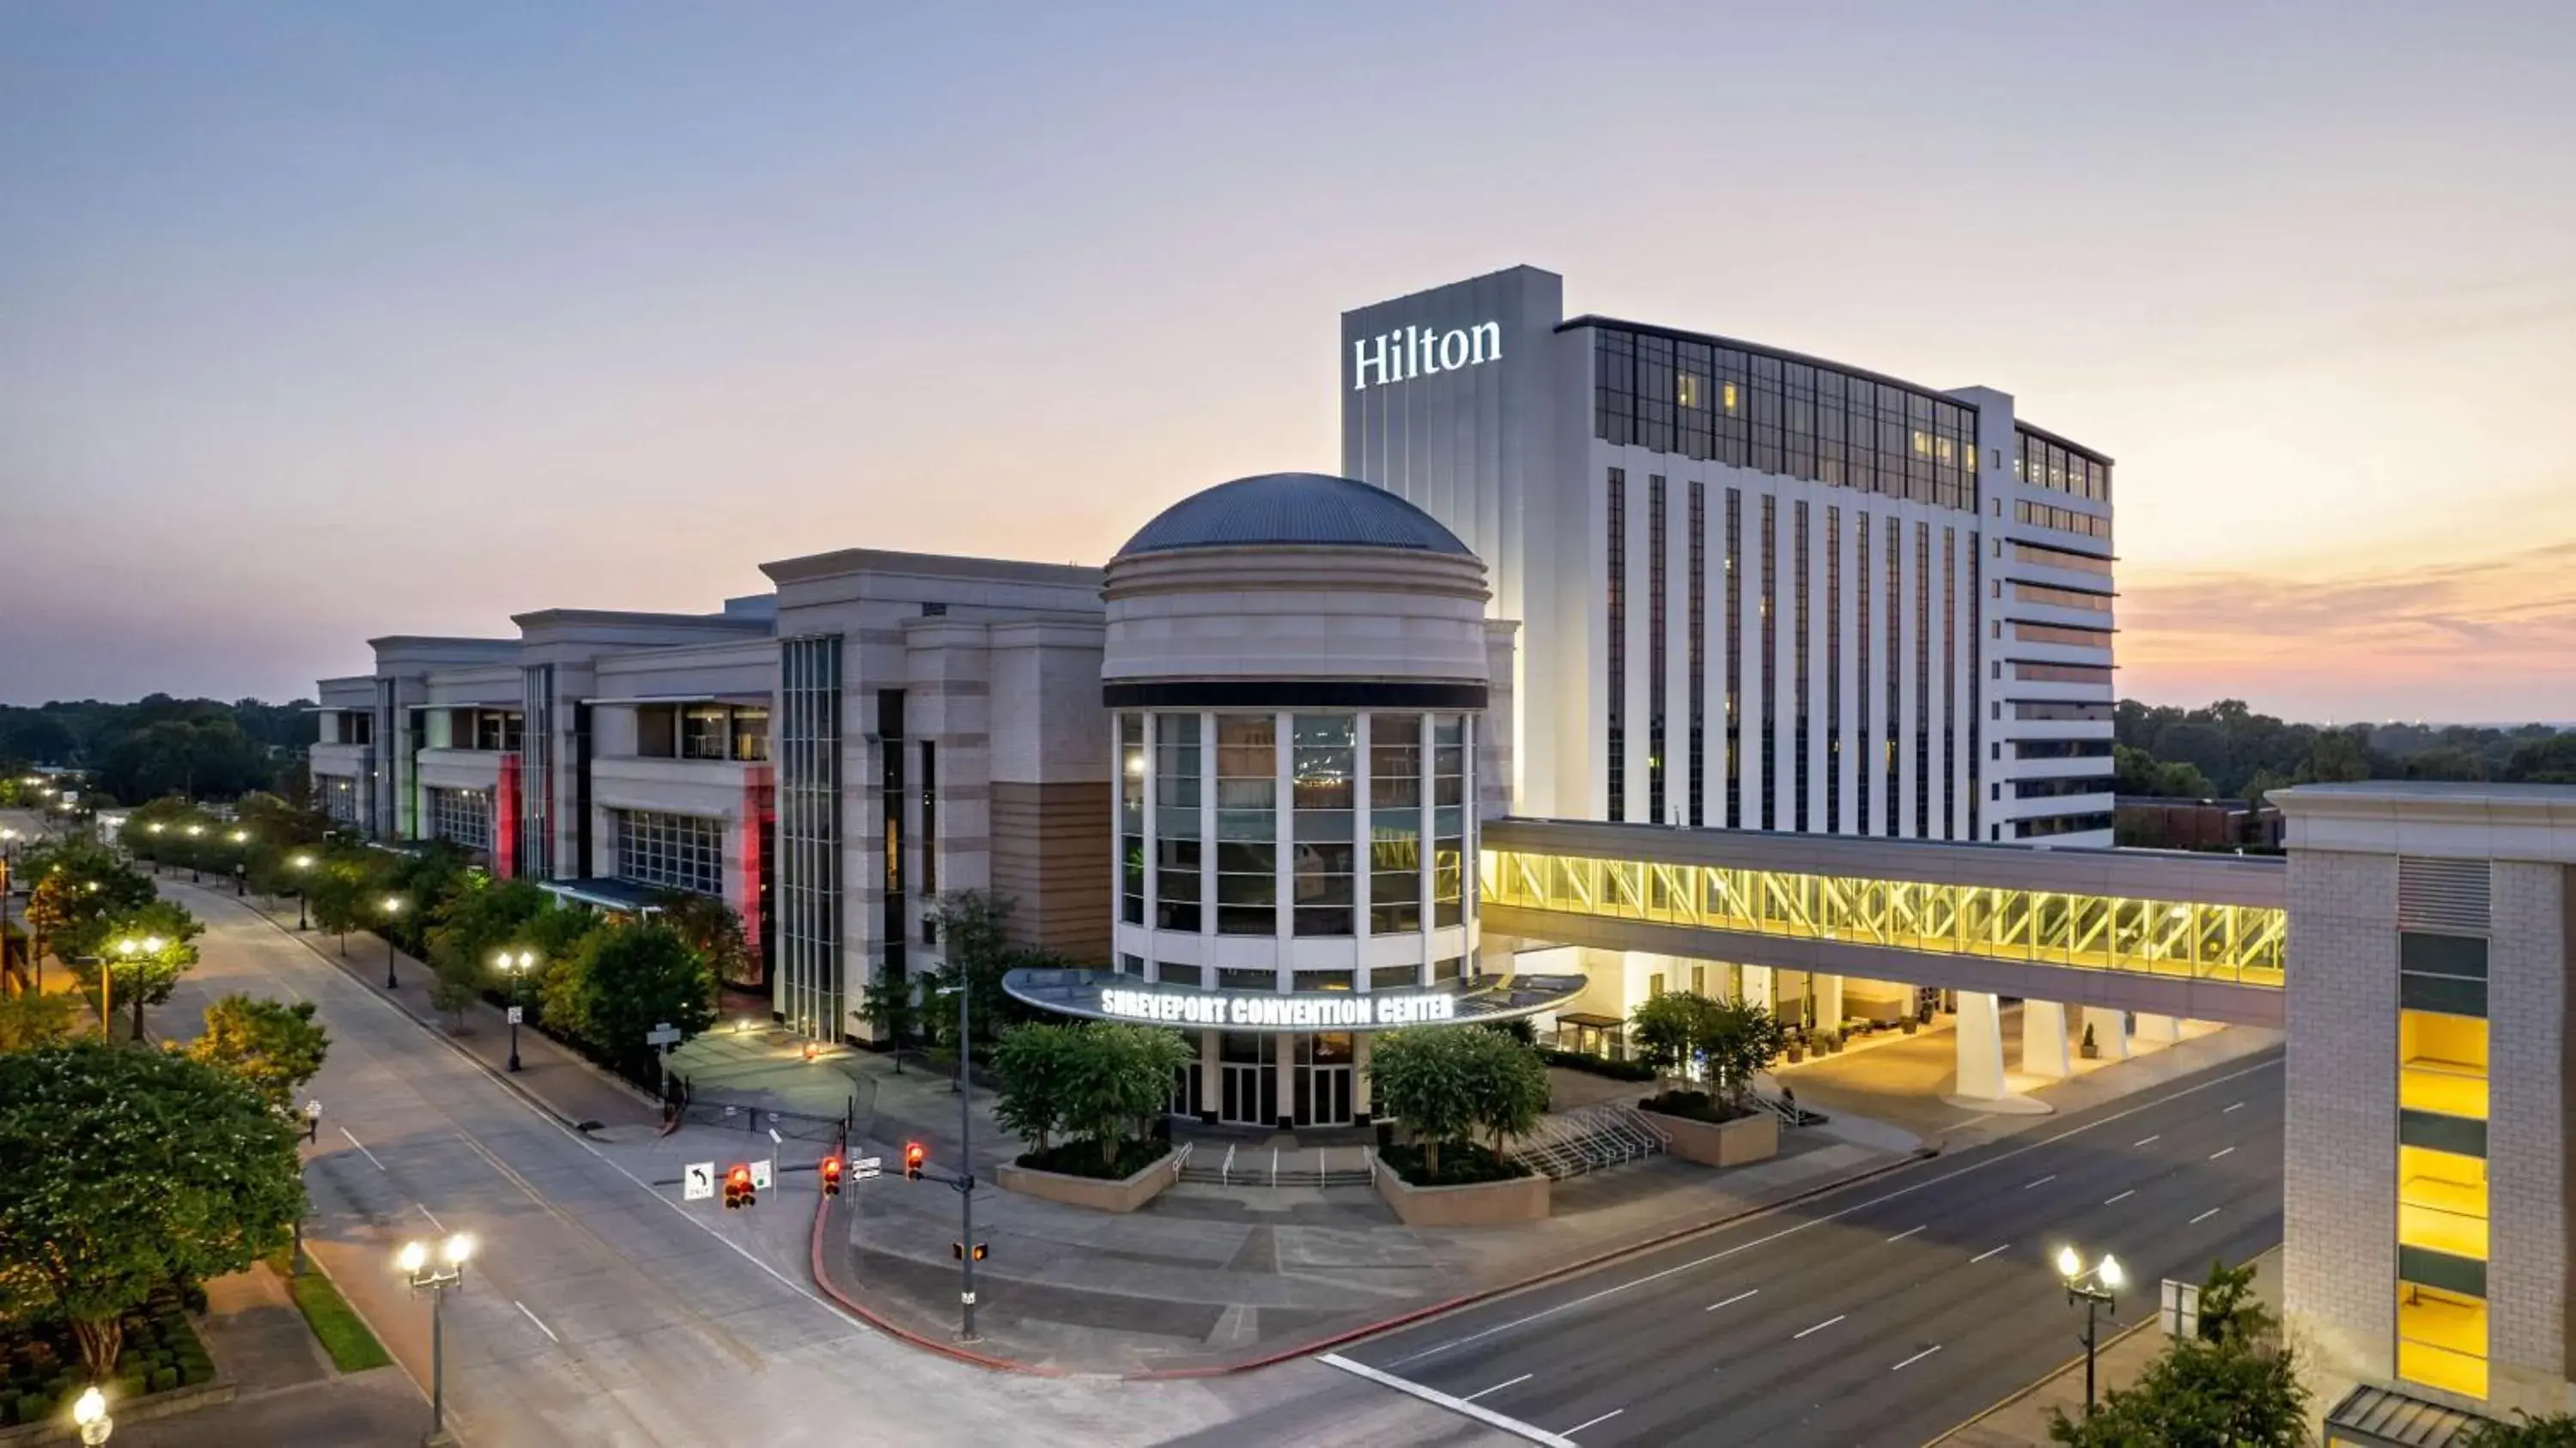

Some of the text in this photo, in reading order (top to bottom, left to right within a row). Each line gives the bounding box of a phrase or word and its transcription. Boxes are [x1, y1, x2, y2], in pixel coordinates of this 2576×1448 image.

[1354, 320, 1502, 390] Hilton
[1102, 989, 1454, 1025] SHREVEPORT CONVENTION CENTER
